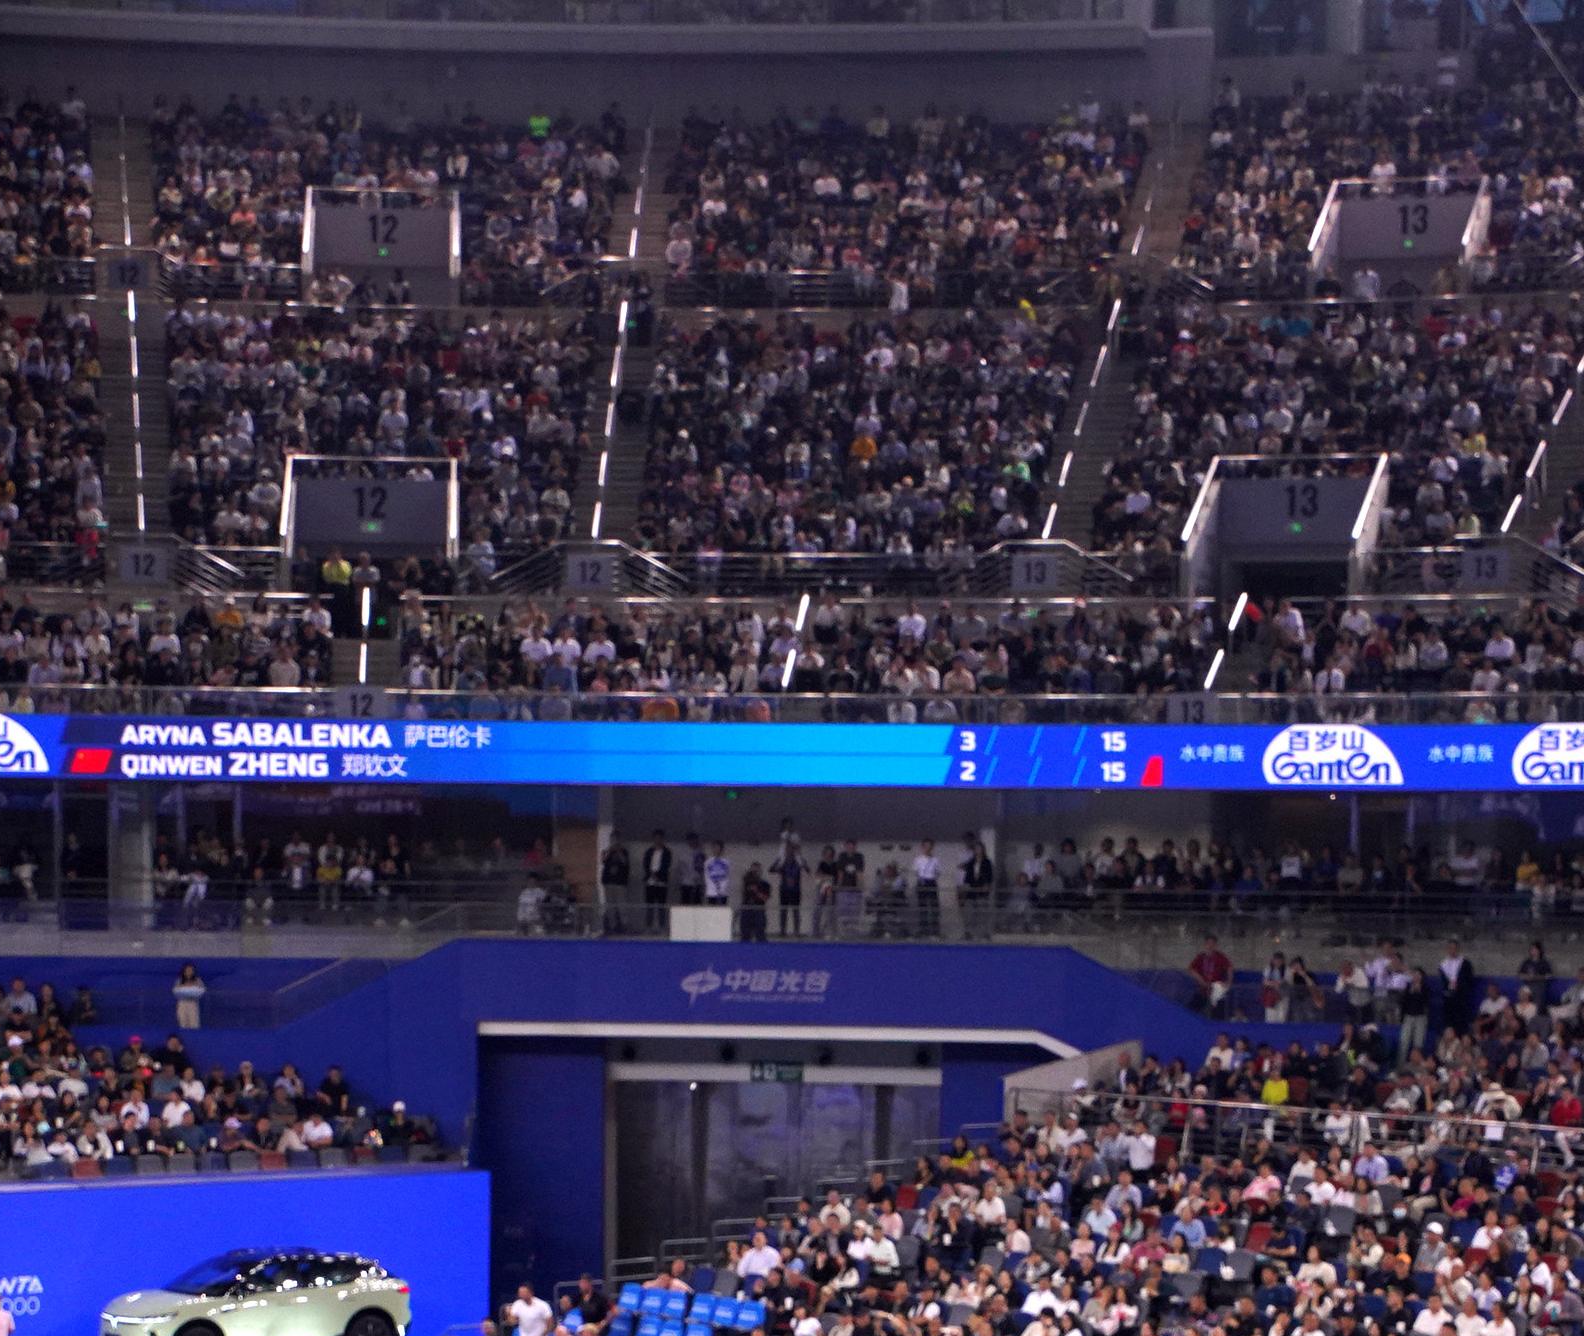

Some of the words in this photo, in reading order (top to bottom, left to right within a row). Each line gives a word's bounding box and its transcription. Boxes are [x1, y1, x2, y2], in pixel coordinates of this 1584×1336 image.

[368, 214, 399, 243] 12
[1399, 206, 1429, 235] 13
[353, 487, 386, 518] 12
[1285, 487, 1318, 517] 13
[132, 552, 156, 577] 12
[578, 560, 602, 585] 12
[1023, 562, 1047, 586] 13
[1474, 555, 1497, 579] 13
[351, 693, 373, 715] 12
[120, 725, 207, 747] ARYNA
[212, 722, 392, 748] SABALENKA
[404, 725, 491, 749] 萨巴伦卡
[959, 732, 977, 751] 3
[1101, 732, 1126, 751] 15
[1288, 731, 1364, 752] 百岁山
[121, 753, 222, 778] QINWEN
[228, 752, 329, 777] ZHENG
[342, 753, 408, 777] 郑钦文
[960, 762, 976, 781] 2
[1101, 763, 1126, 782] 15
[1, 1295, 41, 1317] 000
